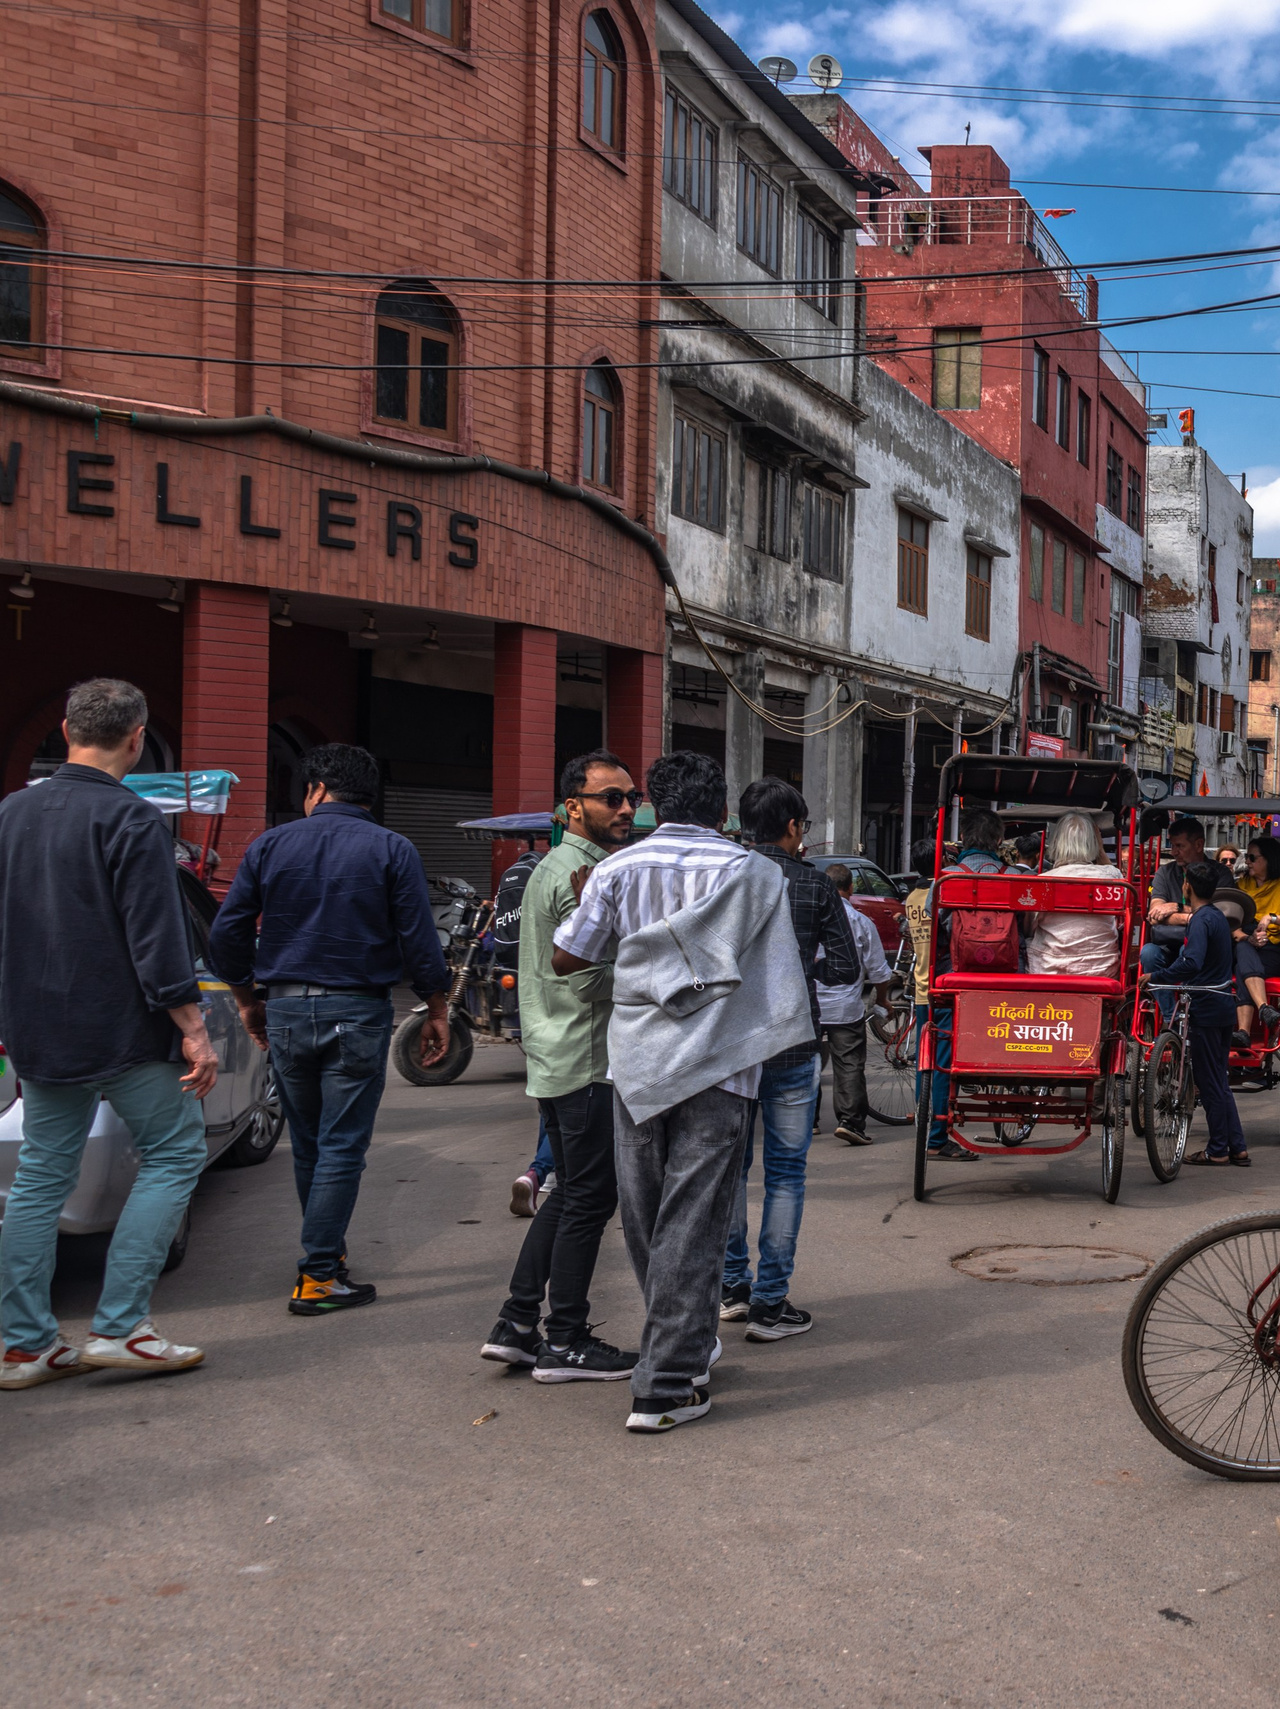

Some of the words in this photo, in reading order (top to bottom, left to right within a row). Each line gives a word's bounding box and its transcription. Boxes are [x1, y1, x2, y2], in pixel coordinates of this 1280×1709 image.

[988, 1001, 1035, 1021] चाँदनी
[1038, 1003, 1074, 1021] चौक
[987, 1022, 1011, 1039] की
[1013, 1021, 1074, 1041] सवारी!
